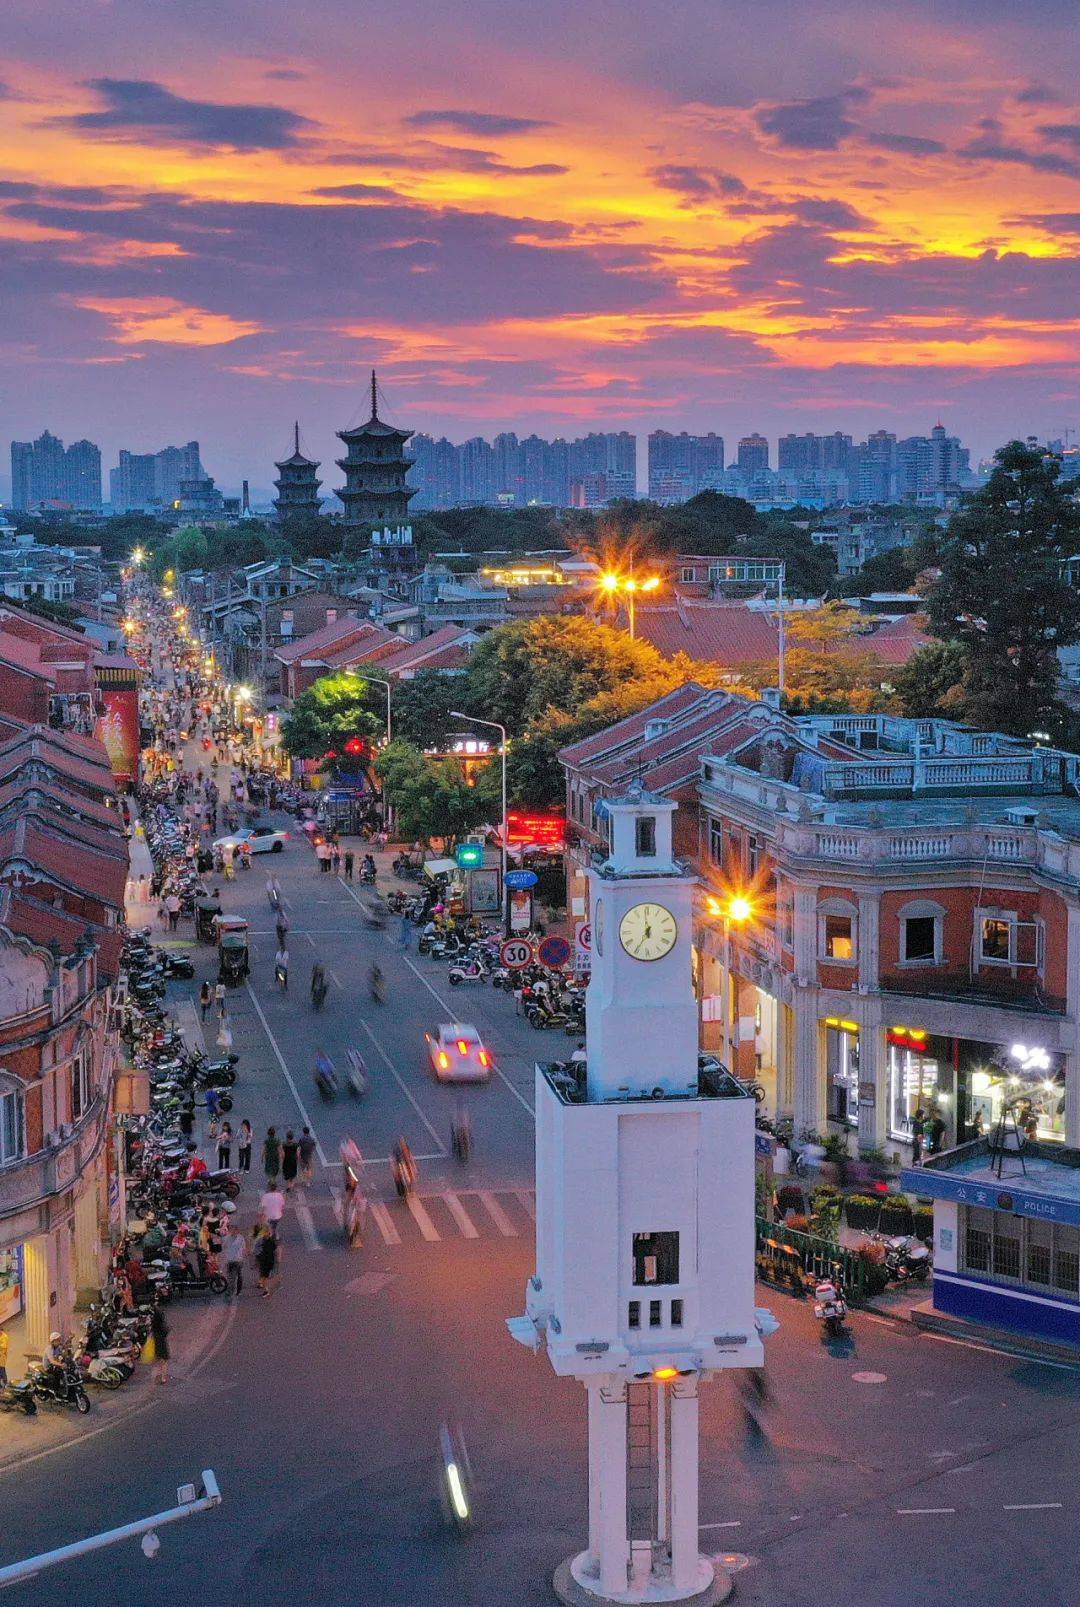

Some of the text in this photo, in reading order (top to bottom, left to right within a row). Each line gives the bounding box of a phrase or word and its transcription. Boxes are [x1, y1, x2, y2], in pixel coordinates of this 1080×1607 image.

[507, 947, 527, 962] 30
[956, 1187, 987, 1202] 公安
[1024, 1201, 1056, 1215] POLICE
